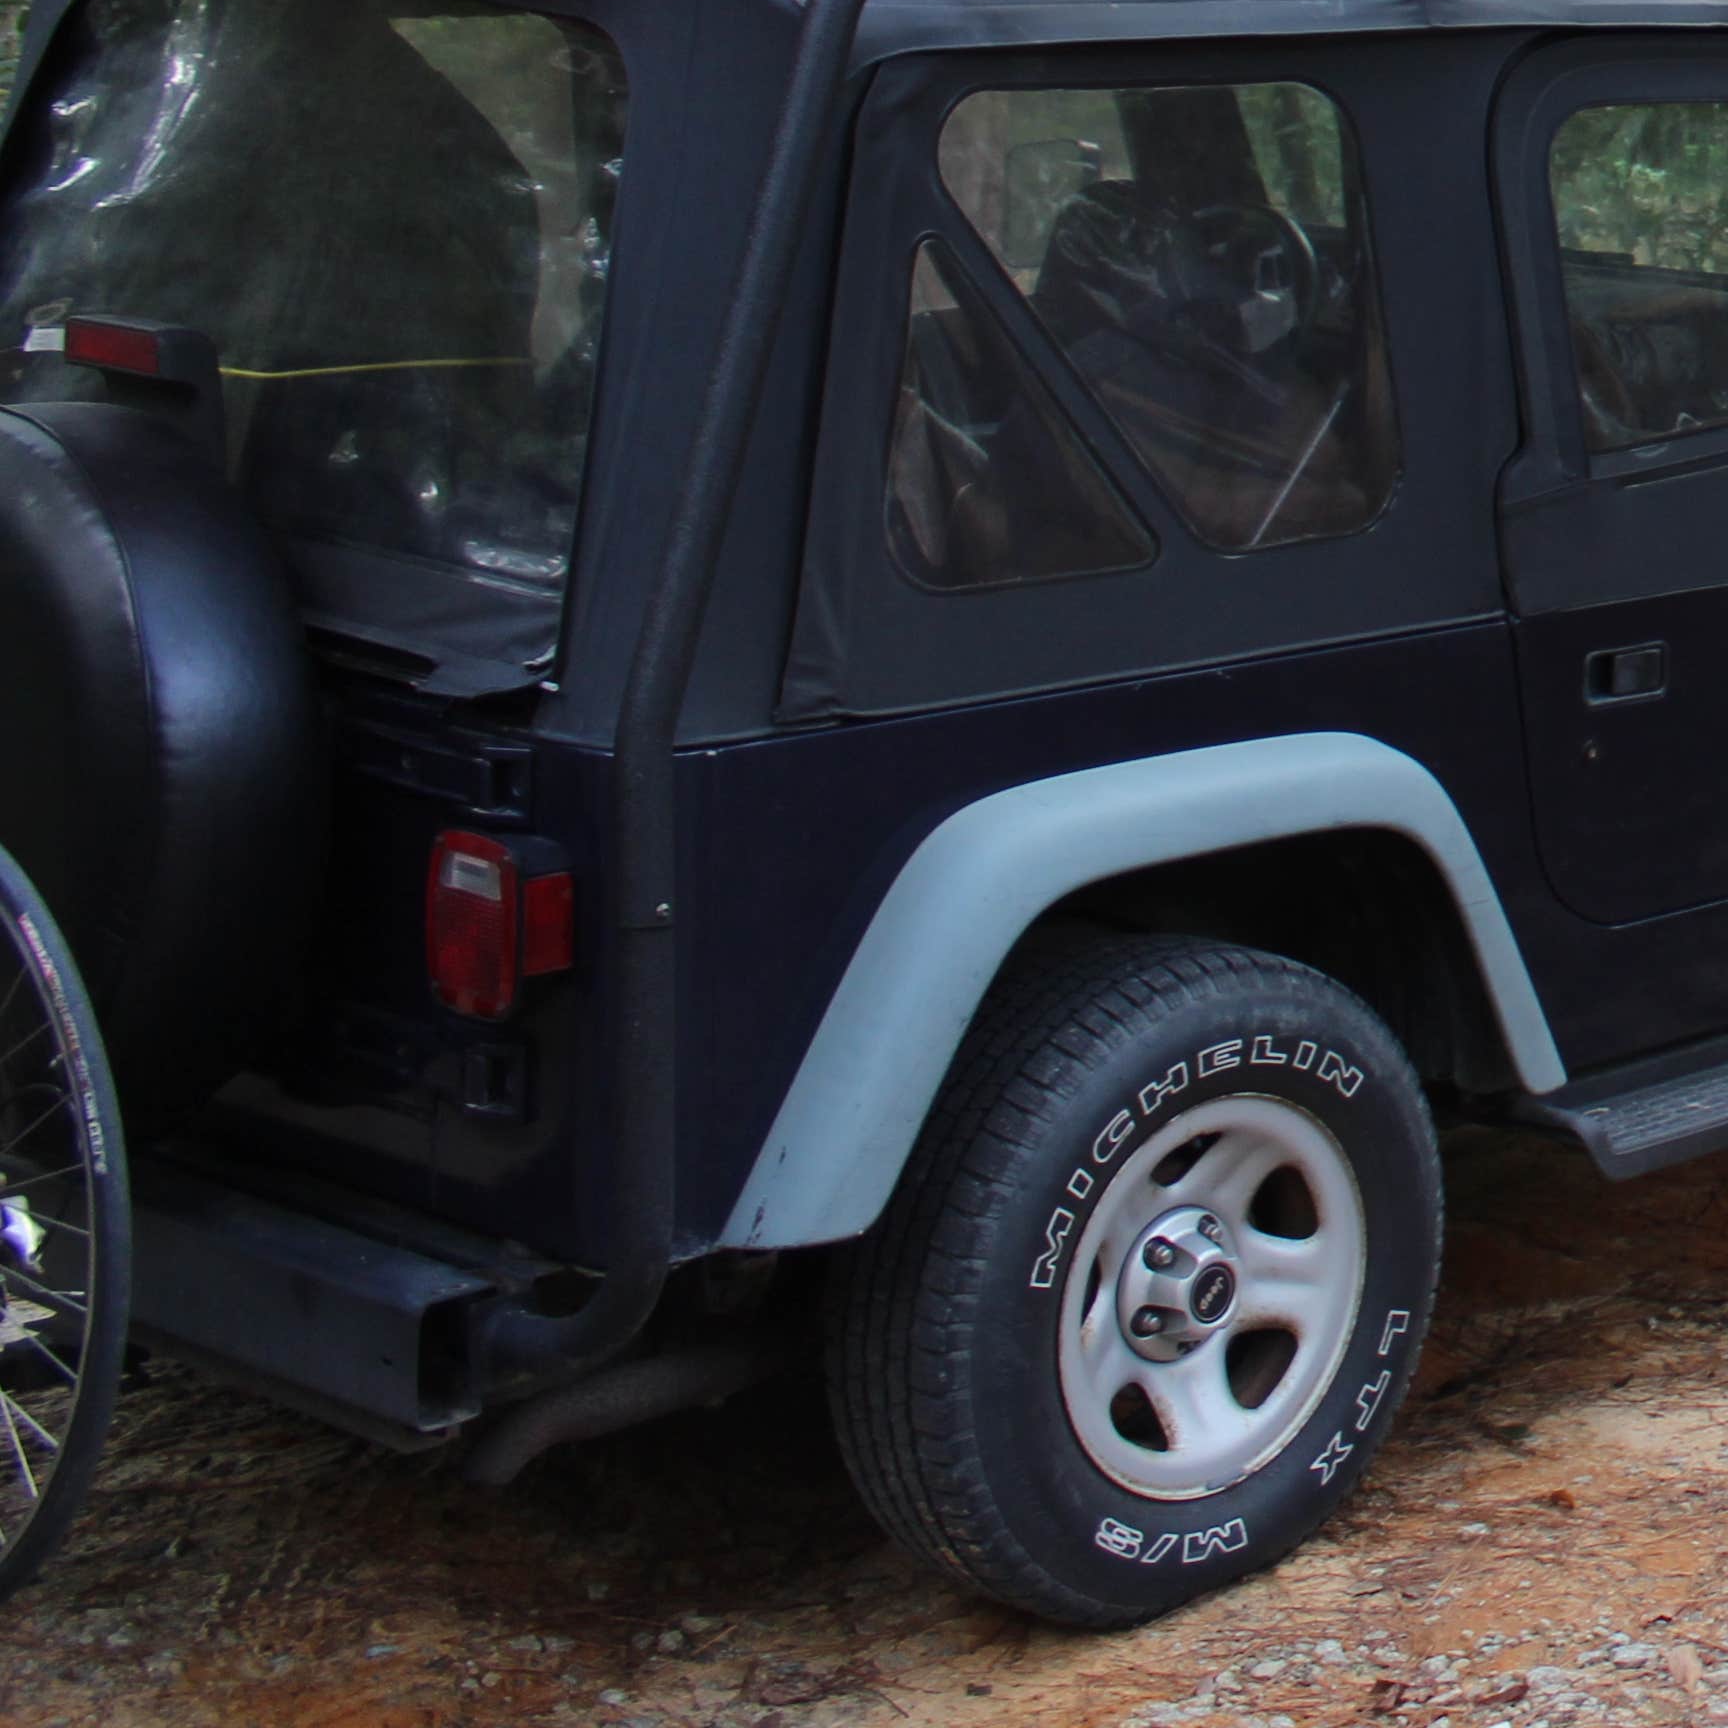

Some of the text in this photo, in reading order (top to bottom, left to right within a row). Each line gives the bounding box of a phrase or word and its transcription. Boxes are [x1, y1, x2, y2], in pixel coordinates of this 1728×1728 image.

[1030, 1035, 1365, 1288] MICHELIN
[1310, 1310, 1410, 1486] LTX
[1095, 1517, 1249, 1564] M/S
